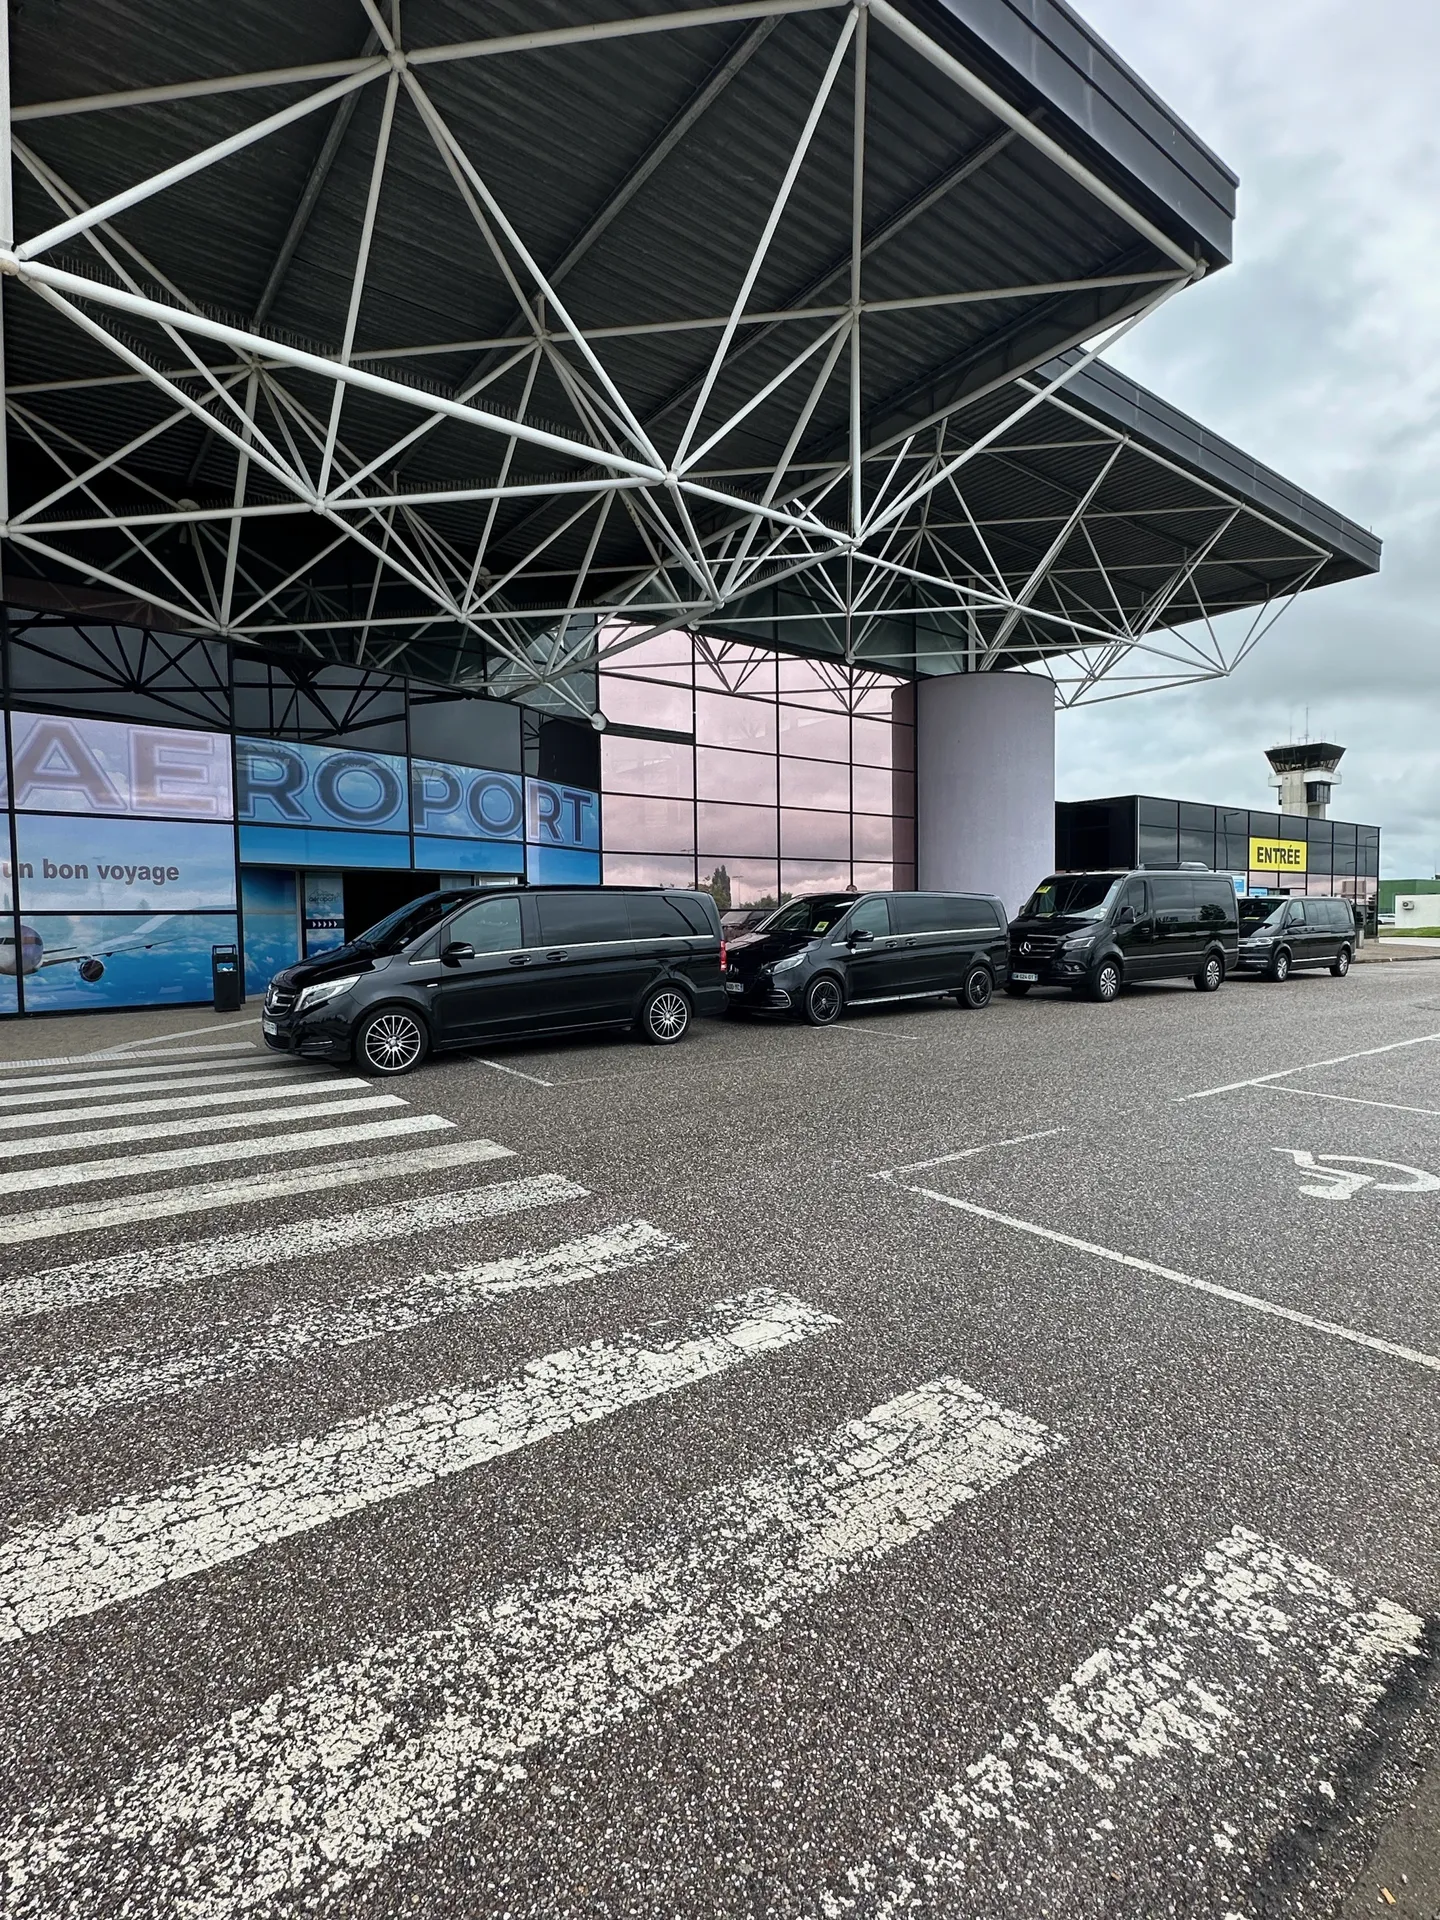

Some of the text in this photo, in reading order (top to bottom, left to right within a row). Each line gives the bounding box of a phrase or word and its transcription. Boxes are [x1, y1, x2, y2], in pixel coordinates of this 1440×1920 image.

[0, 718, 593, 845] AEROPORT
[1256, 845, 1301, 865] ENTRÉE
[43, 858, 89, 879] bon
[97, 864, 180, 886] voyage
